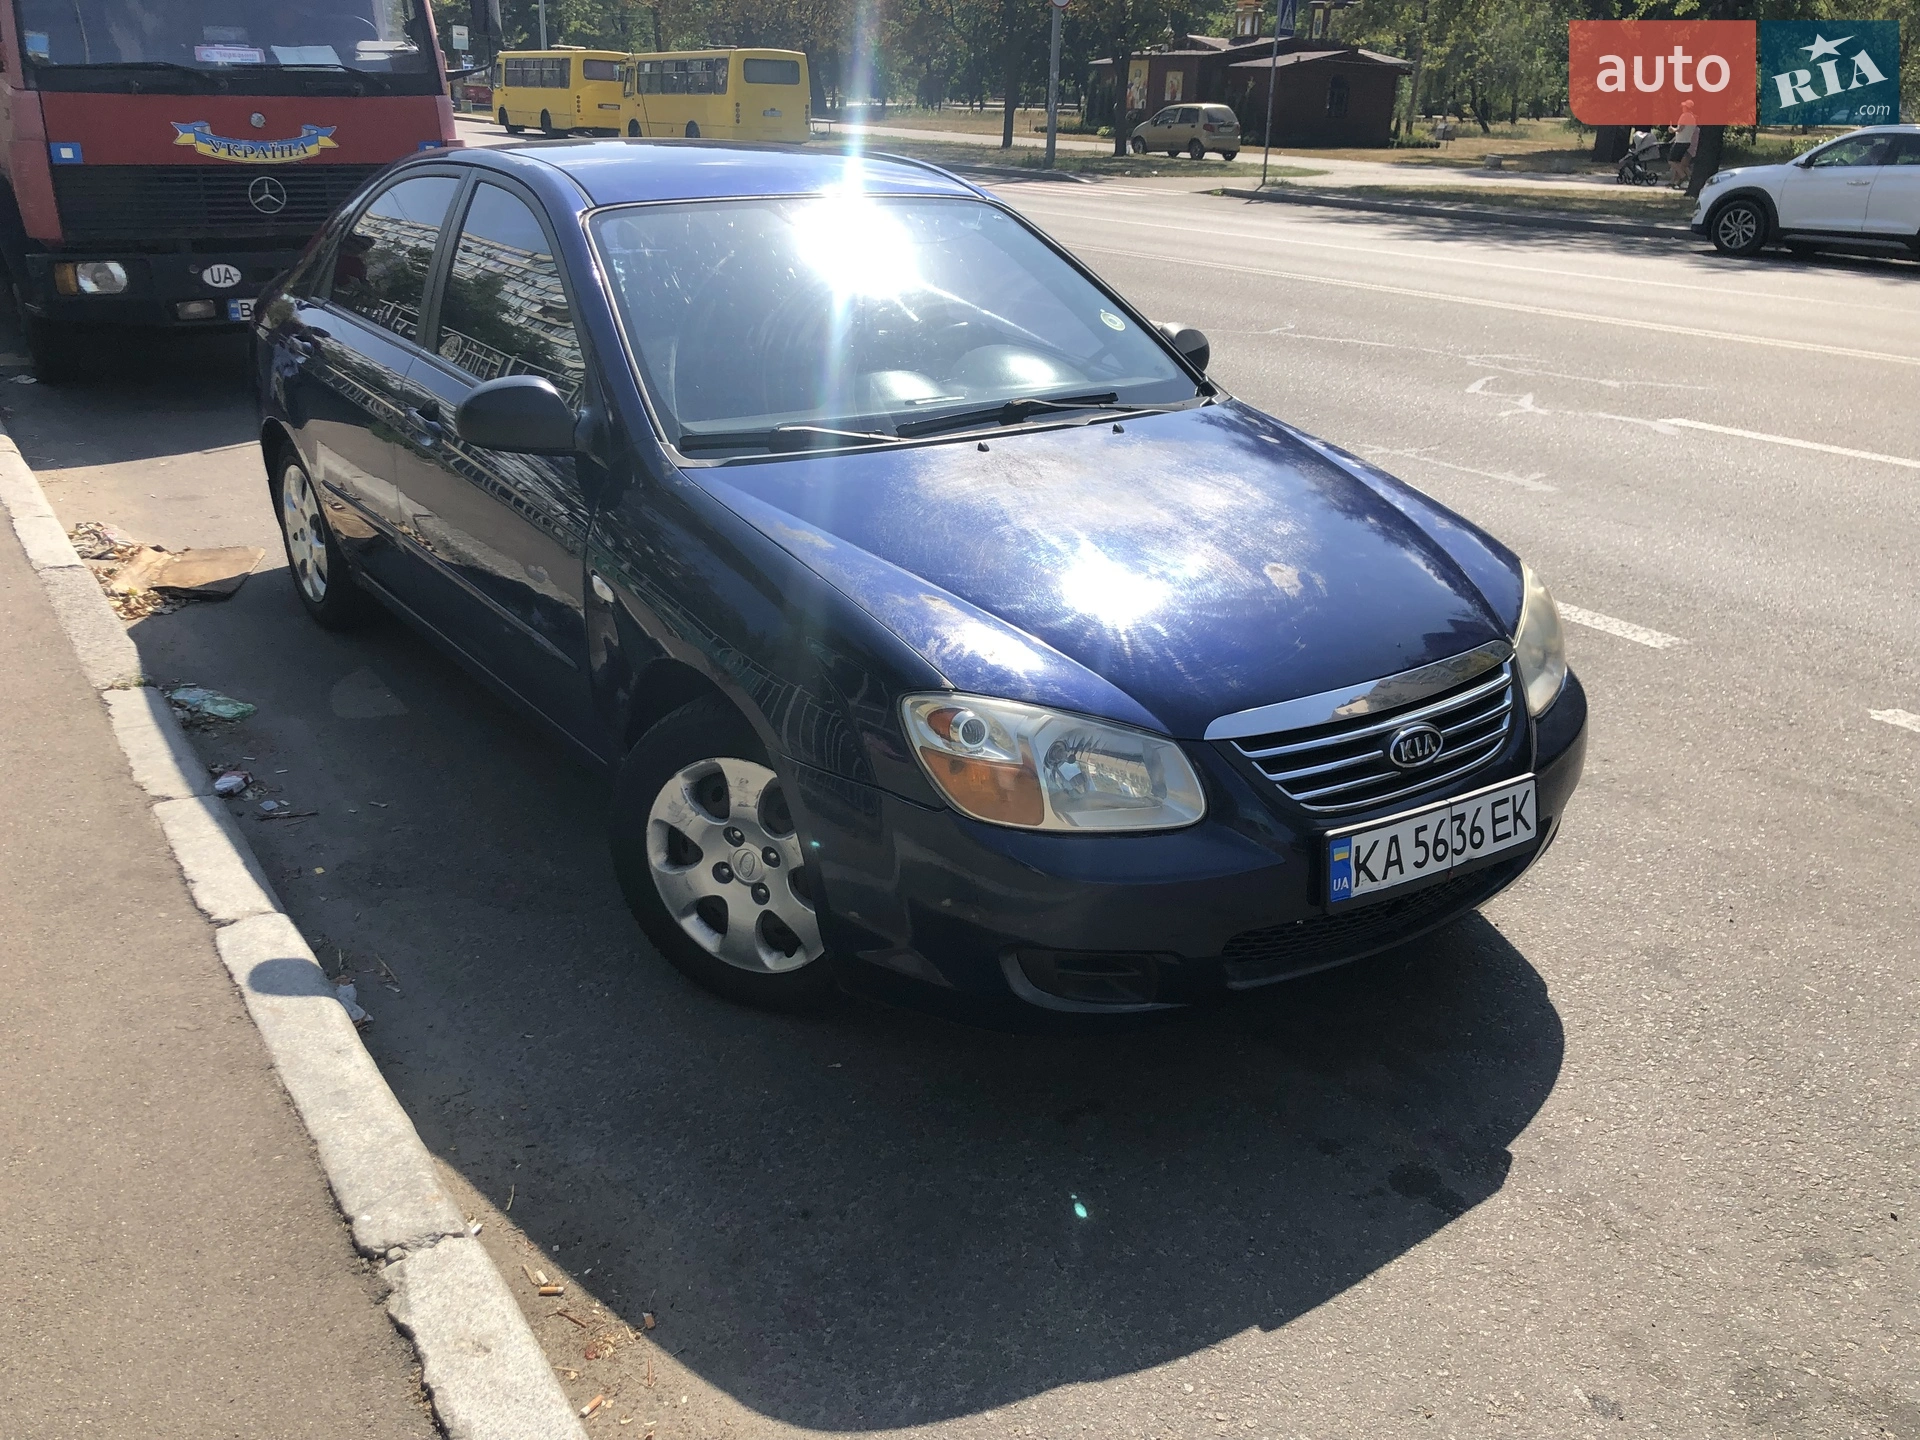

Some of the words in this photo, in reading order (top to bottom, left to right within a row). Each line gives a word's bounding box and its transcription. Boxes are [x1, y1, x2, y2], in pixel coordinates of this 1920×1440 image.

[208, 138, 308, 159] УКРАЇНА
[1399, 733, 1437, 762] KIA
[1353, 834, 1405, 888] KA
[1412, 805, 1486, 870] 5636
[1491, 789, 1532, 844] EK
[1333, 879, 1349, 891] UA
